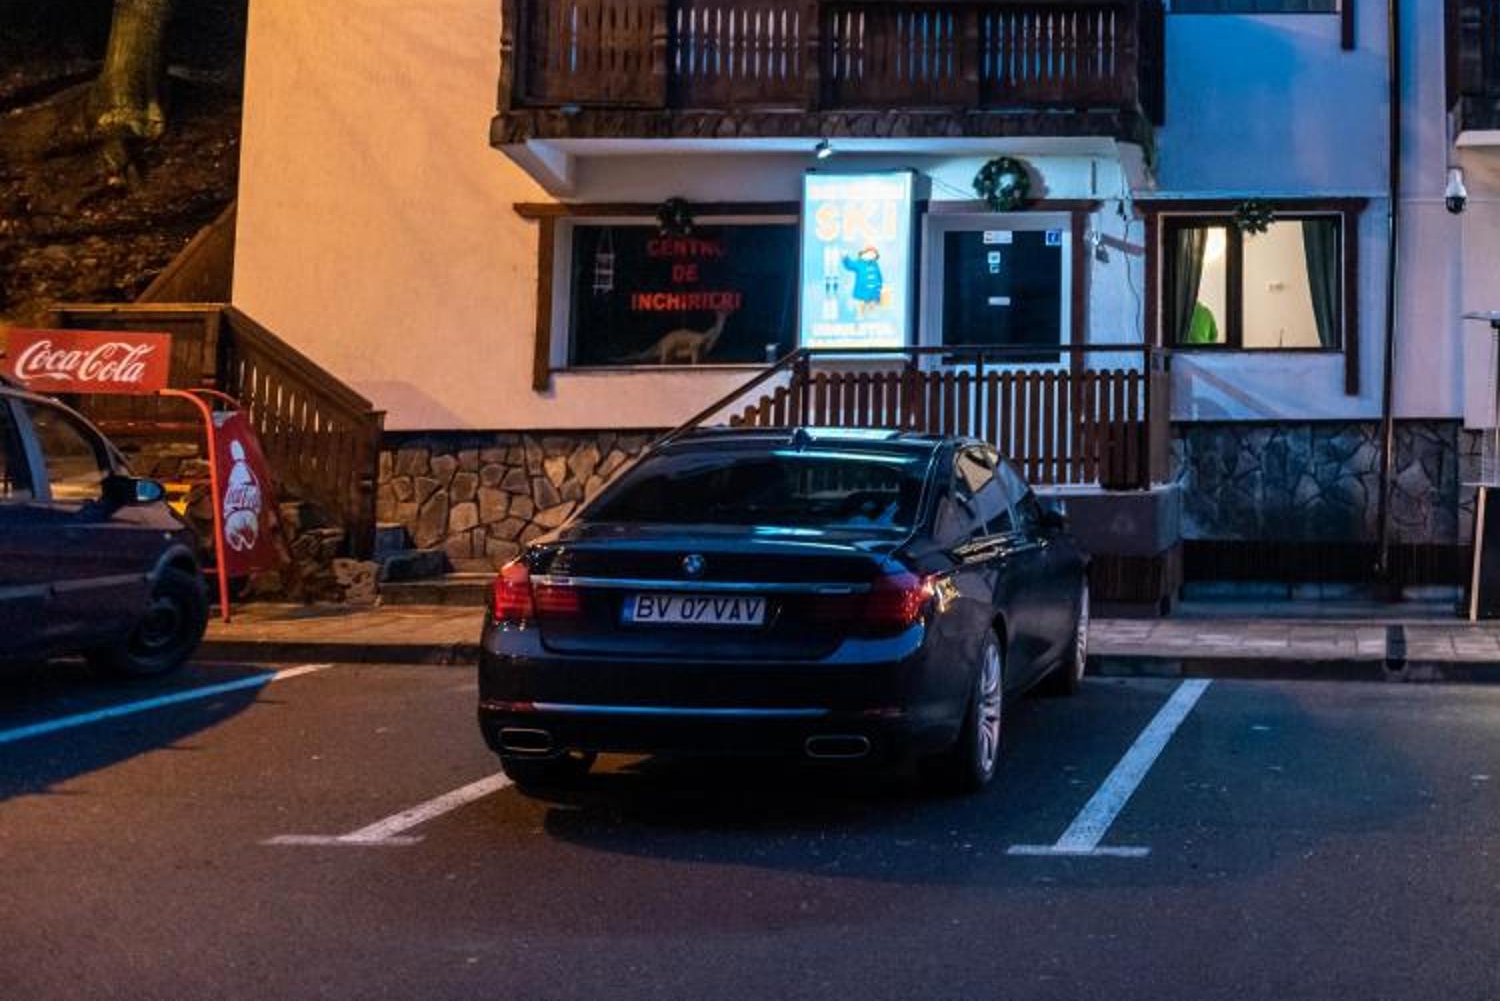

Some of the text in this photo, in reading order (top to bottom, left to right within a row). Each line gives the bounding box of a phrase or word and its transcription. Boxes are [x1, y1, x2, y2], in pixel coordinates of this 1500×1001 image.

[815, 199, 897, 242] SKI
[671, 263, 700, 283] DE
[14, 339, 157, 383] Coca-Cola
[636, 596, 673, 619] BV
